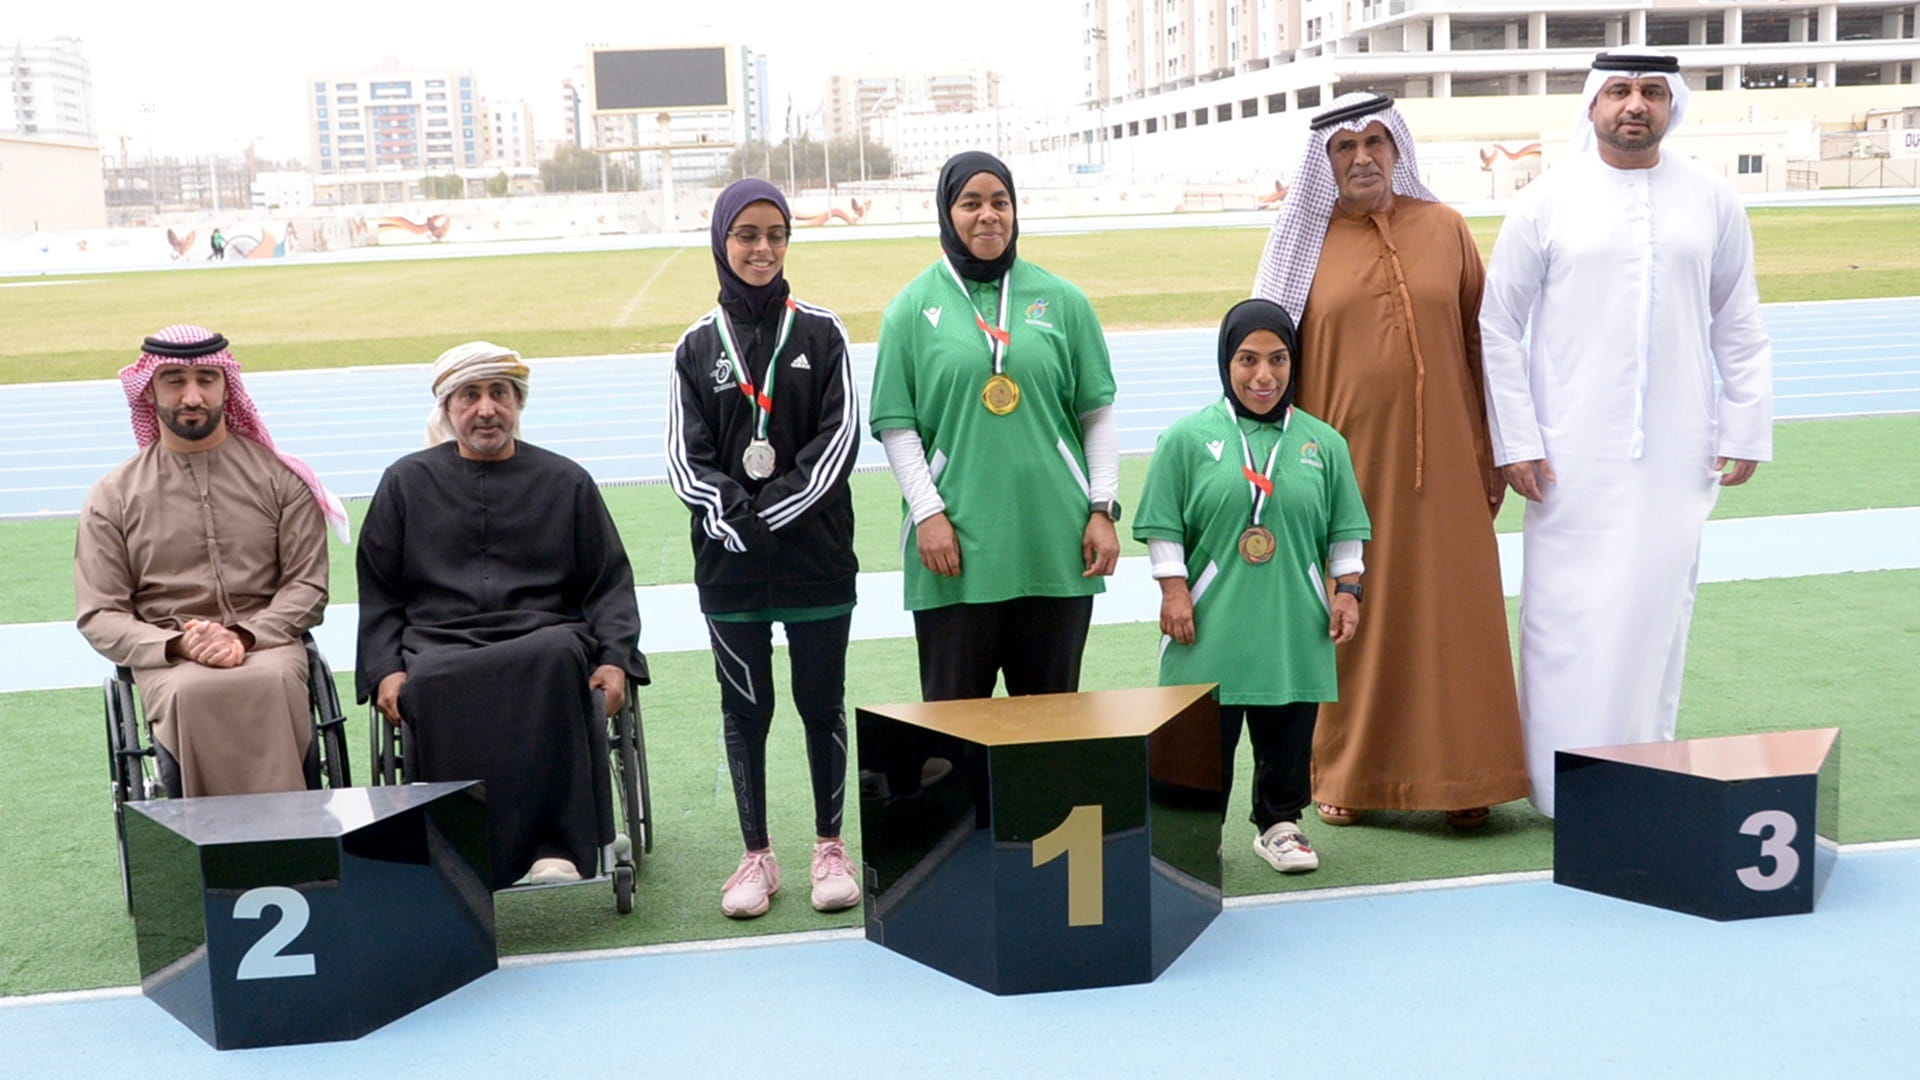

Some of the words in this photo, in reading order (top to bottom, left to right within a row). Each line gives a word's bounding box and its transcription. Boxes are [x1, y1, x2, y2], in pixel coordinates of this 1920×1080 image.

[1032, 804, 1103, 927] 1
[1735, 809, 1799, 891] 3
[232, 886, 317, 980] 2
